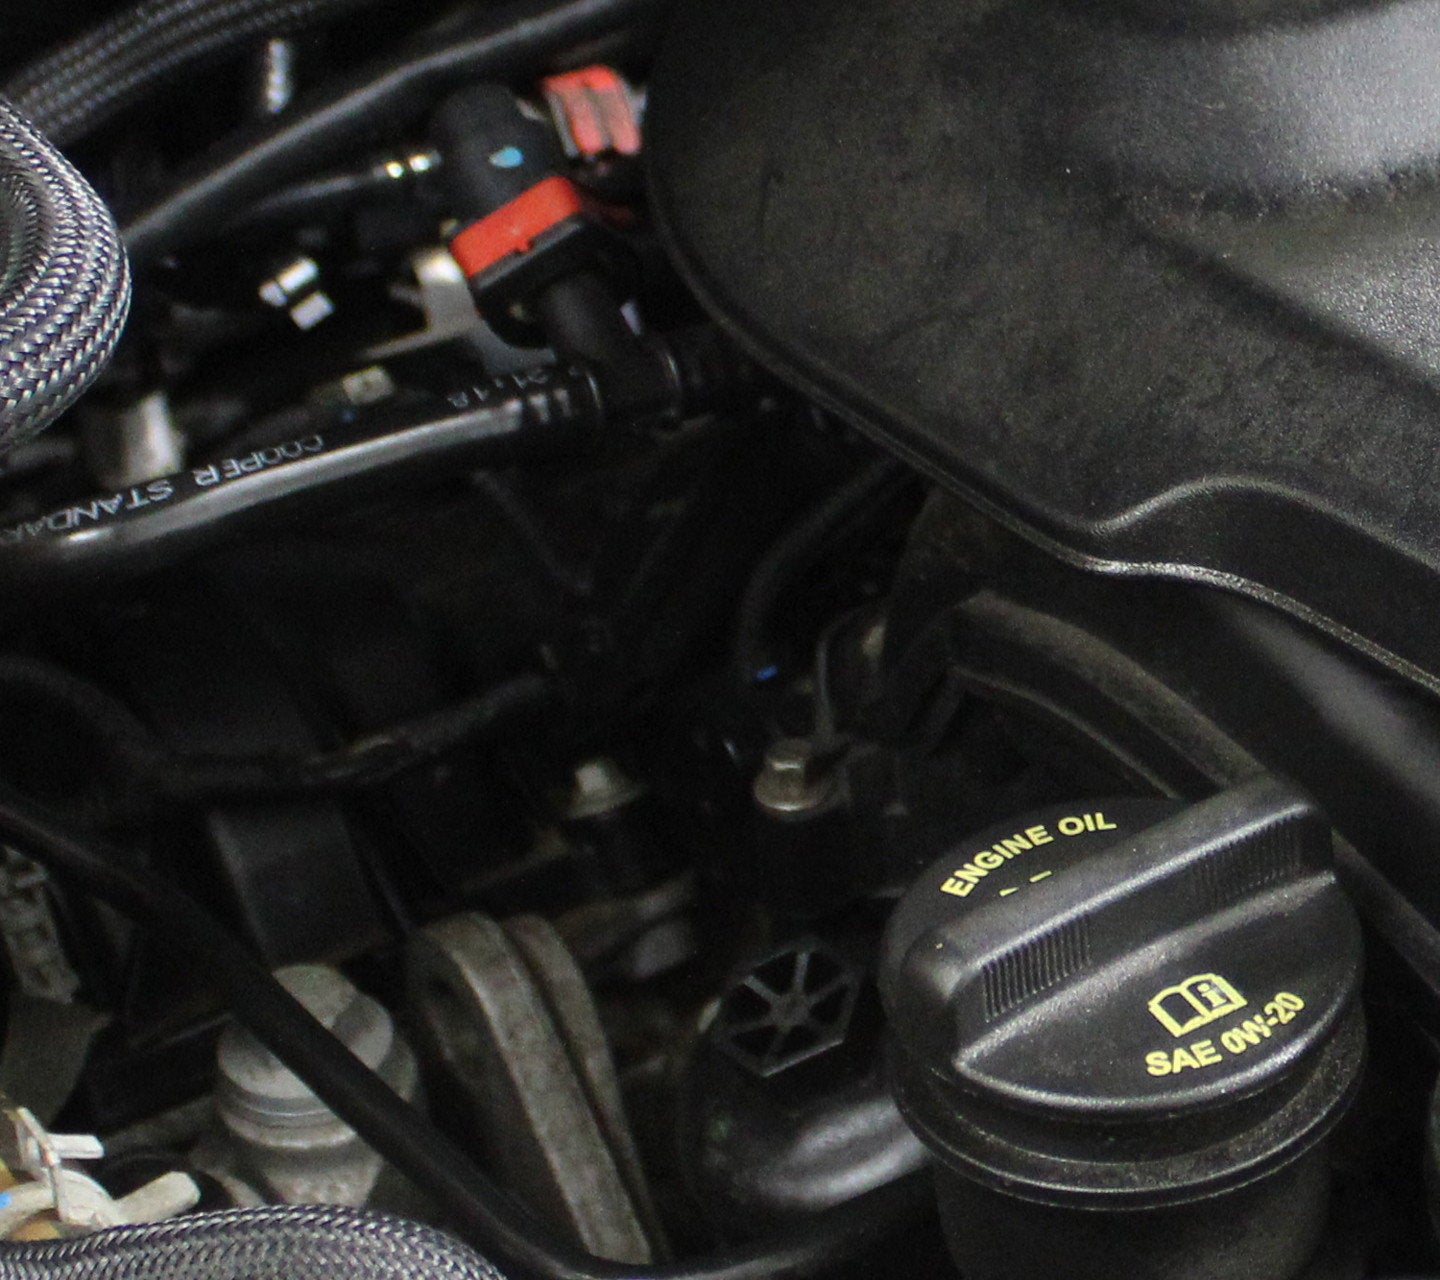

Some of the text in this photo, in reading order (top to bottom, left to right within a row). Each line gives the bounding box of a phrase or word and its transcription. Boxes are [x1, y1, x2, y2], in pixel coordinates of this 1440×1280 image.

[939, 812, 1117, 899] ENGINE OIL
[1144, 991, 1306, 1077] SAE 0W-20
